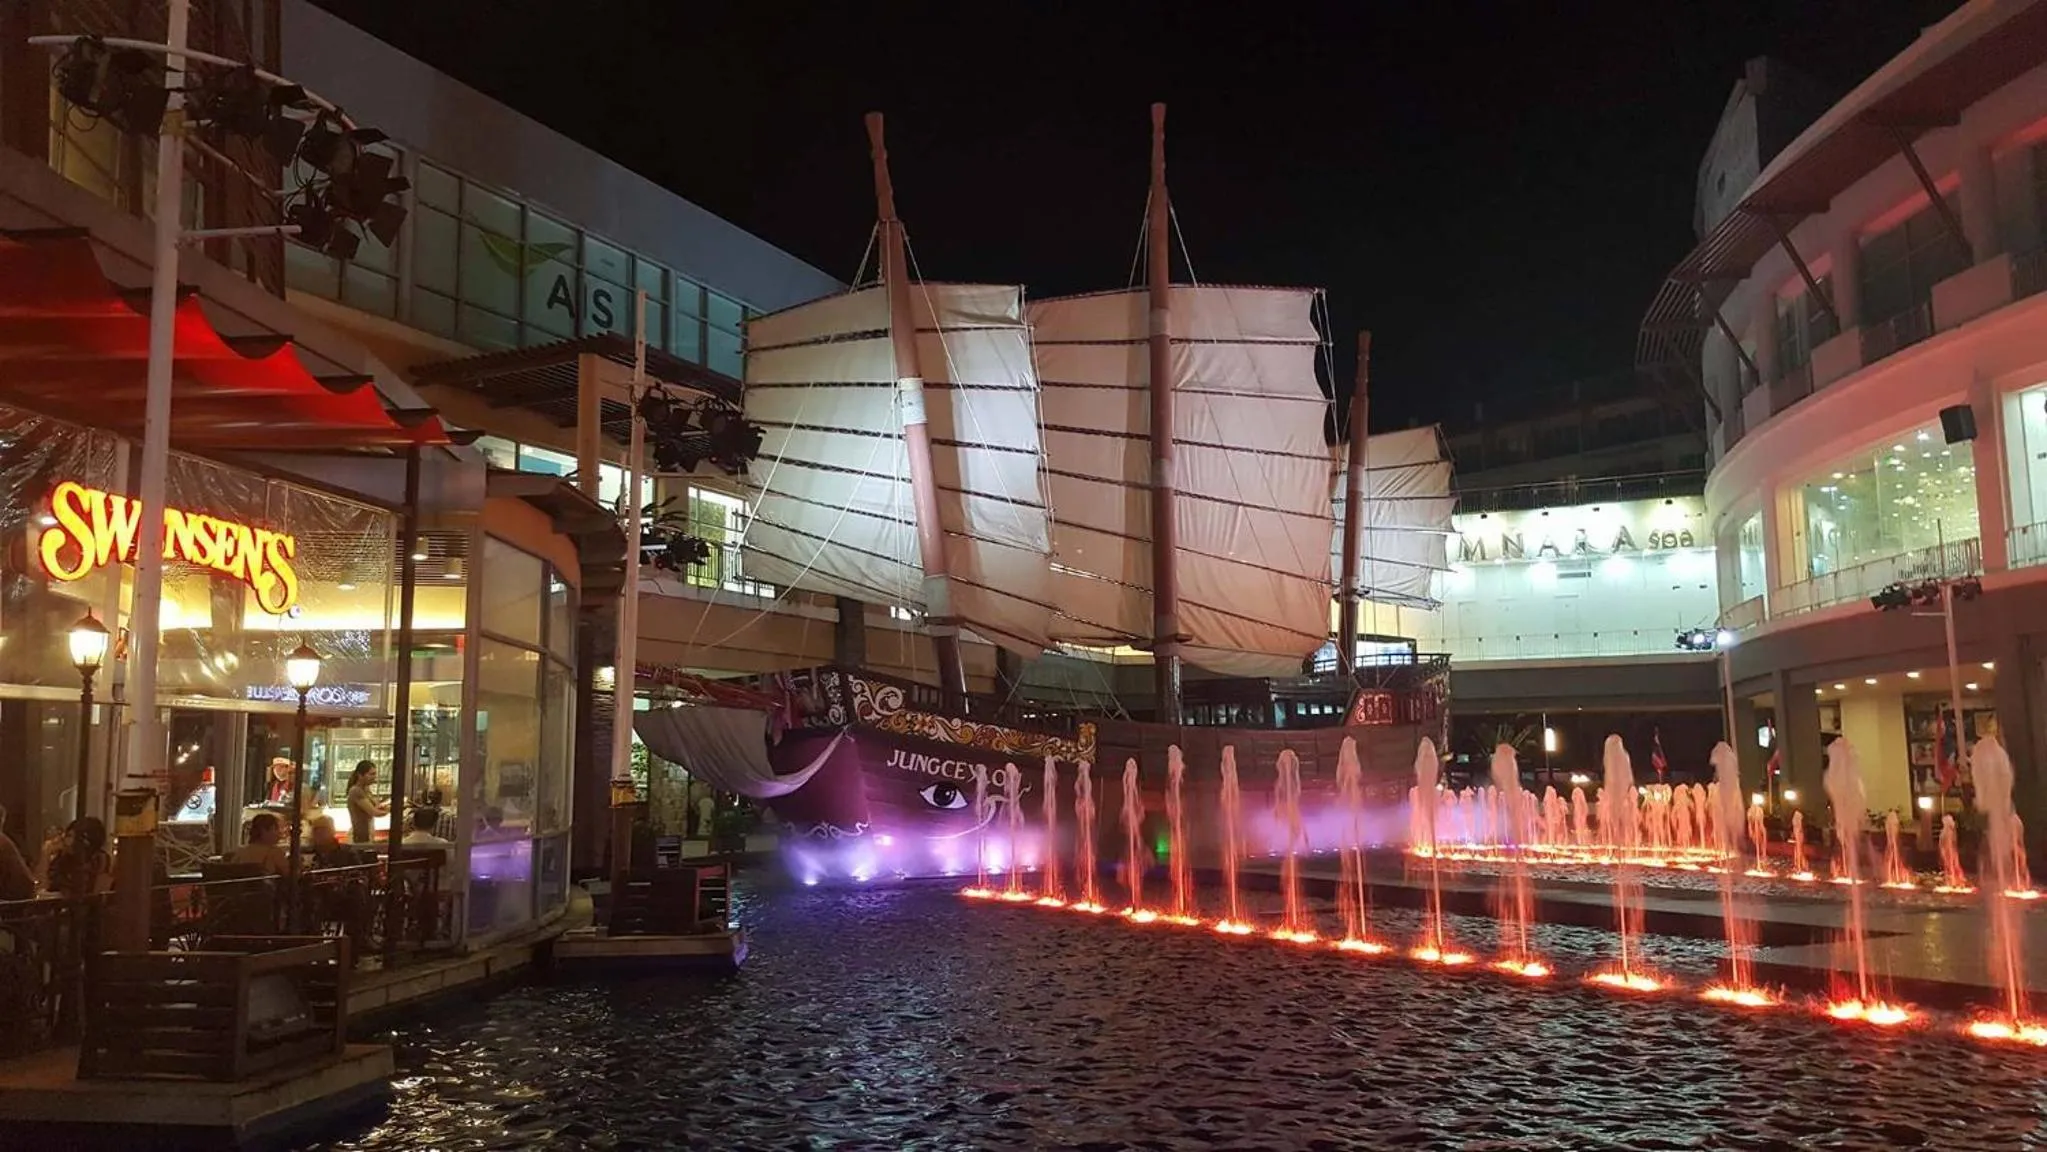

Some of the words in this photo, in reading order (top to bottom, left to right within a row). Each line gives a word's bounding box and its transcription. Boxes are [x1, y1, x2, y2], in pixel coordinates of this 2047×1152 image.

[547, 274, 613, 329] AIS
[41, 481, 298, 614] SWNSEN'S
[887, 750, 1021, 788] JUNGCEYO
